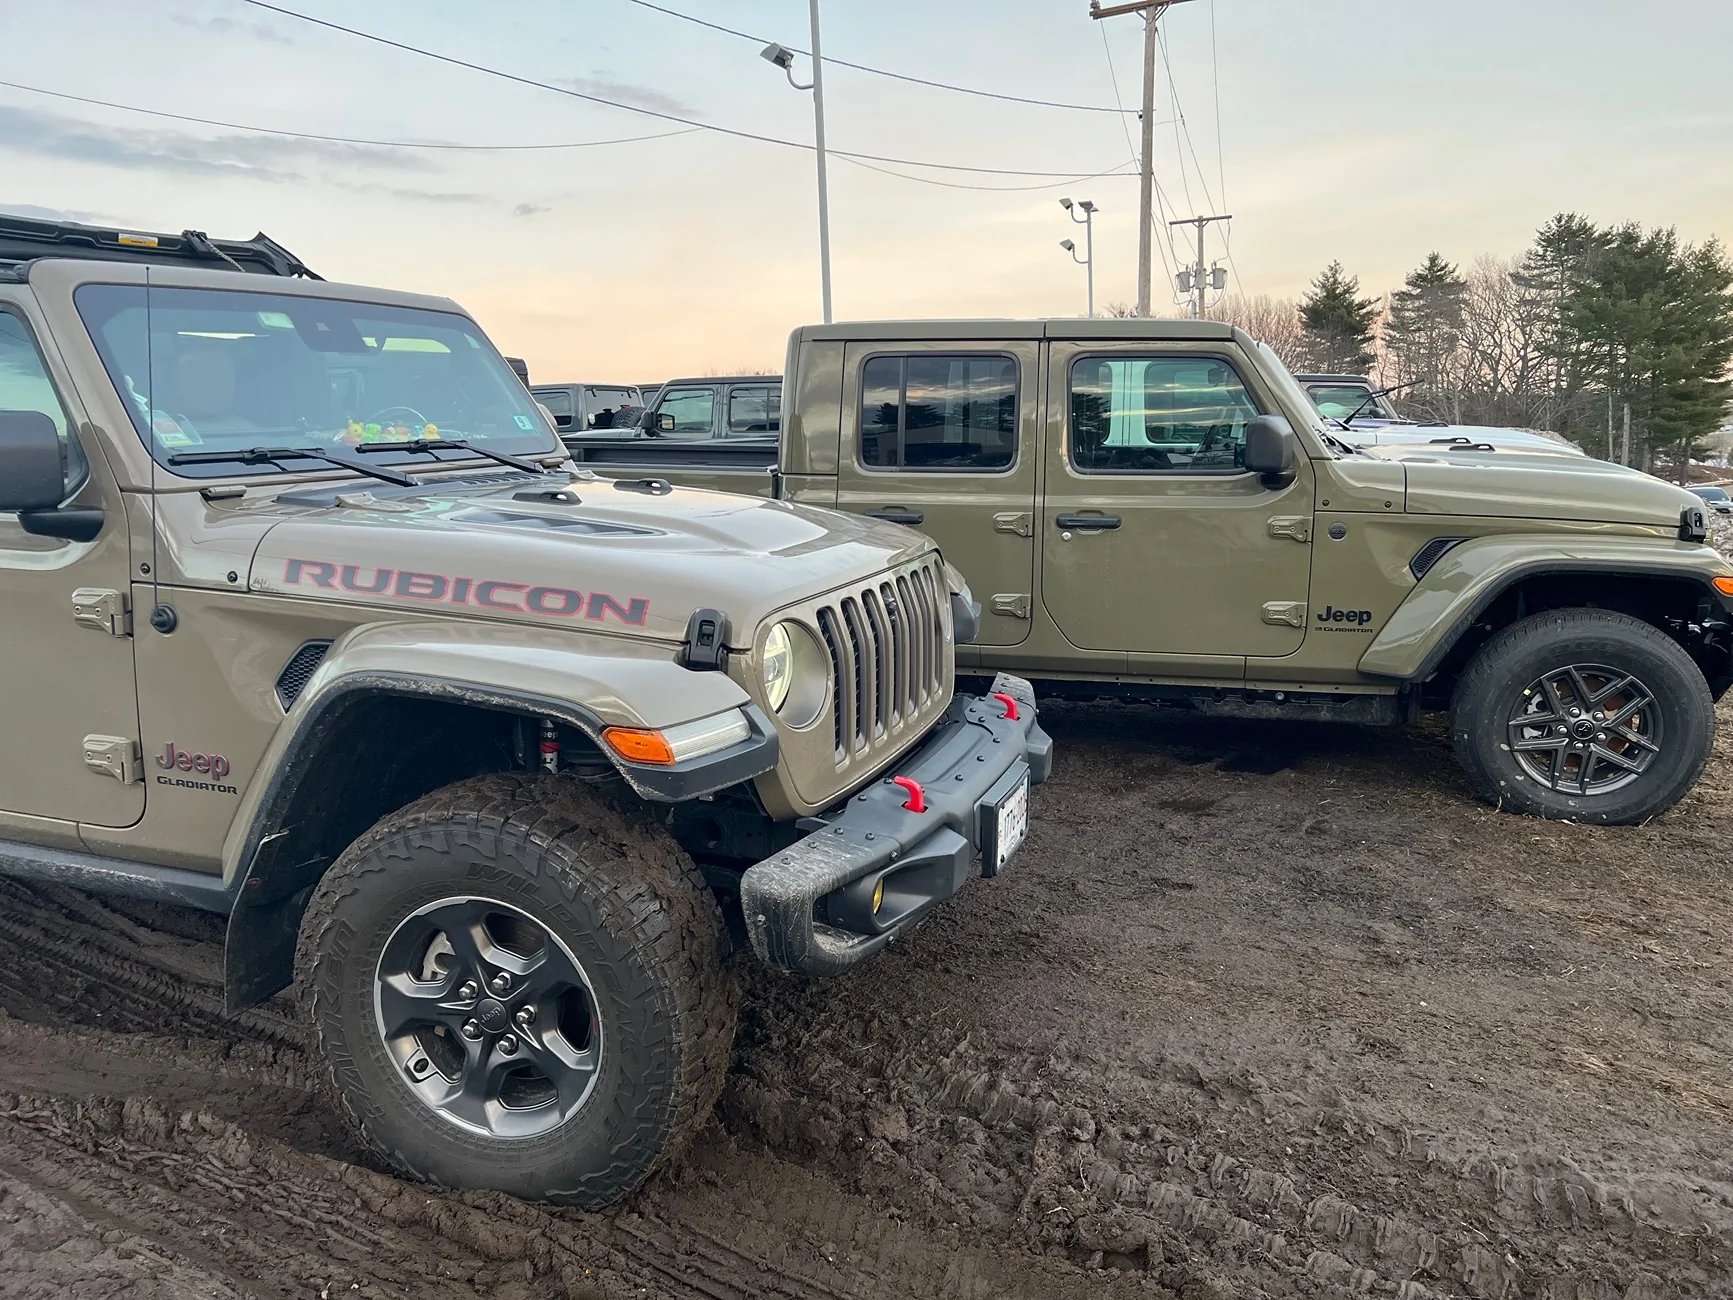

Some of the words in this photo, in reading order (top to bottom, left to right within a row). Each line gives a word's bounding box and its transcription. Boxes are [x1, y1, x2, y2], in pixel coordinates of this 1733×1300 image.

[283, 558, 650, 626] RUBICON
[1317, 605, 1372, 626] Jeep
[155, 741, 230, 781] Jeep
[157, 775, 237, 795] GLADIATOR
[481, 1005, 501, 1023] Jeep
